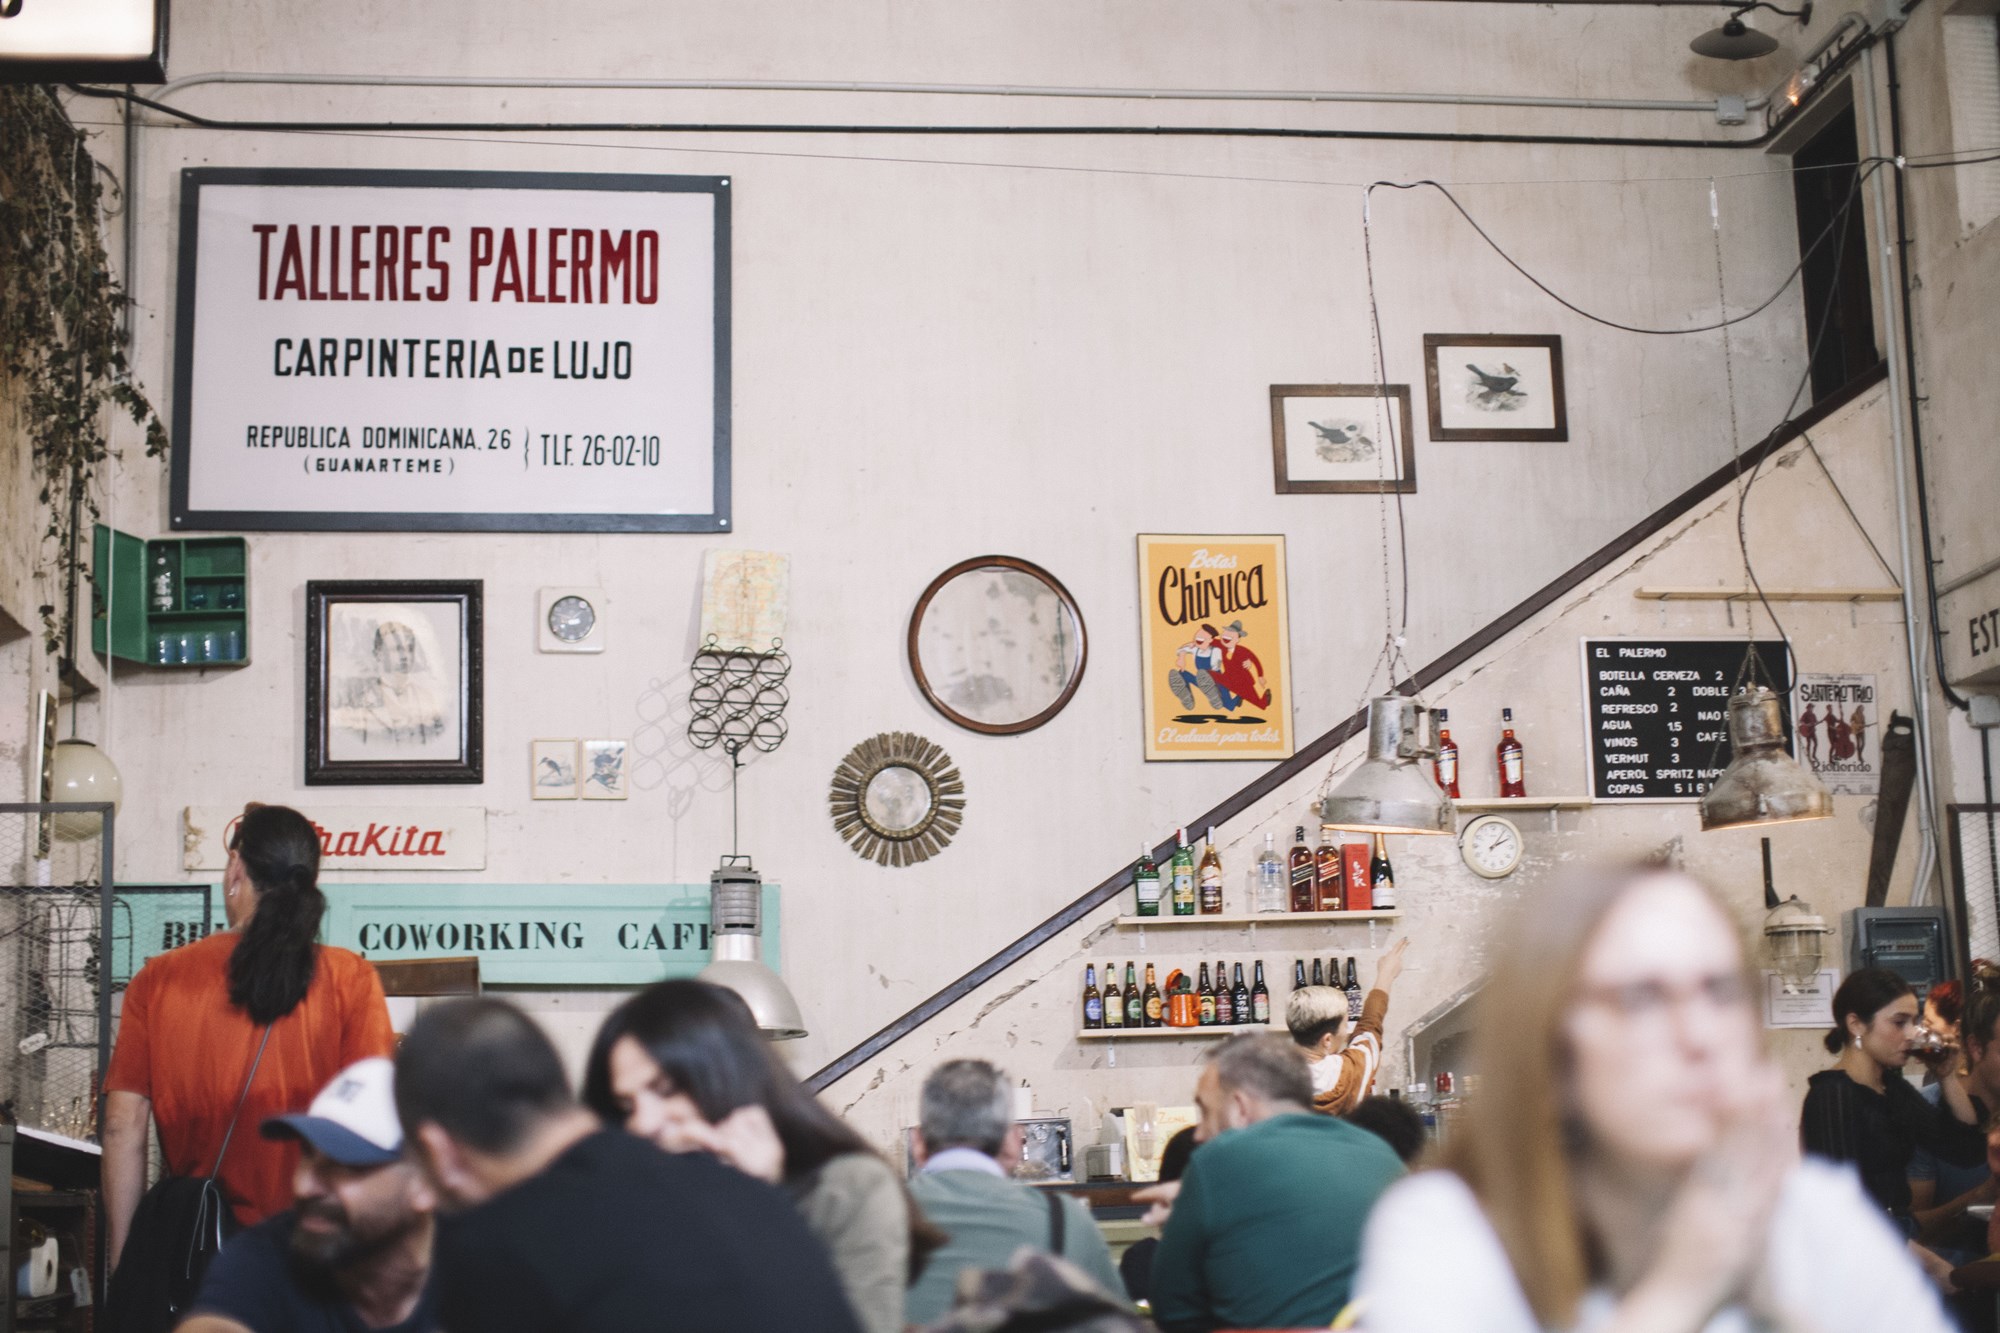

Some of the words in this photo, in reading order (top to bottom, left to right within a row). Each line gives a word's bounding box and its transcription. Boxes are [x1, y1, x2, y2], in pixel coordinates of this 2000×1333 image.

[252, 224, 450, 301] TALLERES
[469, 227, 659, 305] PALERMO
[273, 338, 502, 378] CARPINTERIA
[508, 347, 544, 373] DE
[553, 341, 632, 379] LUJO
[246, 425, 351, 448] REPUBLICA
[487, 429, 511, 449] 26
[541, 434, 574, 466] TLF.
[582, 434, 660, 466] 26-02-10
[1189, 548, 1238, 569] Botas
[1158, 564, 1268, 626] Chiruca
[1596, 647, 1610, 658] EL
[1618, 647, 1667, 658] PALERMO
[1599, 670, 1646, 681] BOTELLA
[1653, 670, 1701, 681] CERVEZA
[1715, 670, 1724, 681] 2
[1600, 684, 1631, 697] CAÑA
[1667, 686, 1676, 697] 2
[1692, 686, 1729, 697] DOBLE
[1601, 703, 1659, 714] REFRESCO
[1669, 702, 1678, 713] 2
[1601, 720, 1632, 730] AGUA
[1158, 727, 1177, 744] El
[1603, 737, 1639, 748] VINOS
[1670, 737, 1679, 747] 3
[1604, 753, 1650, 764] VERMUT
[1671, 753, 1680, 763] 3
[1606, 769, 1649, 780] APEROL
[1655, 769, 1694, 779] SPRITZ
[1607, 783, 1645, 794] COPAS
[1674, 783, 1683, 793] 5
[1696, 783, 1705, 793] 6
[358, 922, 585, 951] COWORKING
